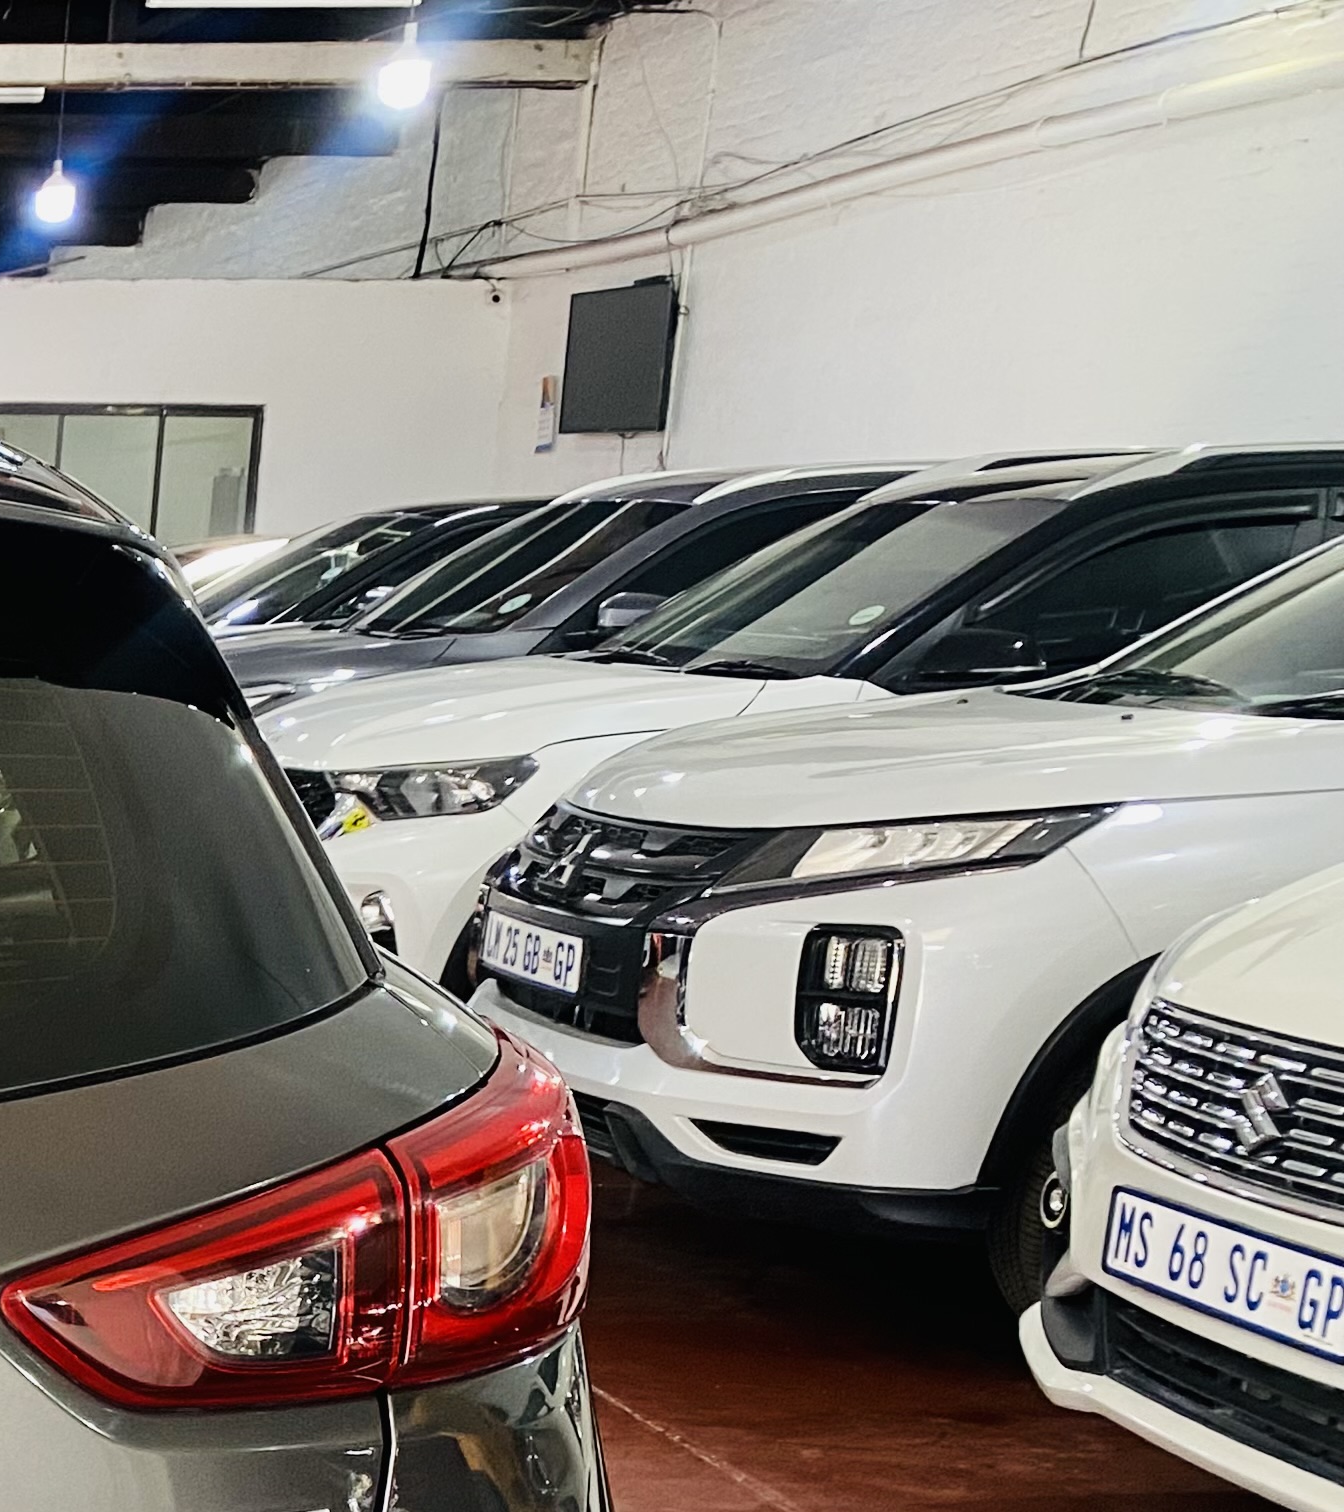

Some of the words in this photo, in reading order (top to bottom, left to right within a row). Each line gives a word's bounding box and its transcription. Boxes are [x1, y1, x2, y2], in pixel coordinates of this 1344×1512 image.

[503, 926, 520, 967] 25
[523, 932, 541, 975] GB
[554, 941, 575, 987] GP
[1115, 1202, 1154, 1269] MS
[1168, 1223, 1208, 1289] 68
[1224, 1243, 1268, 1311] SC
[1298, 1269, 1344, 1338] GP
